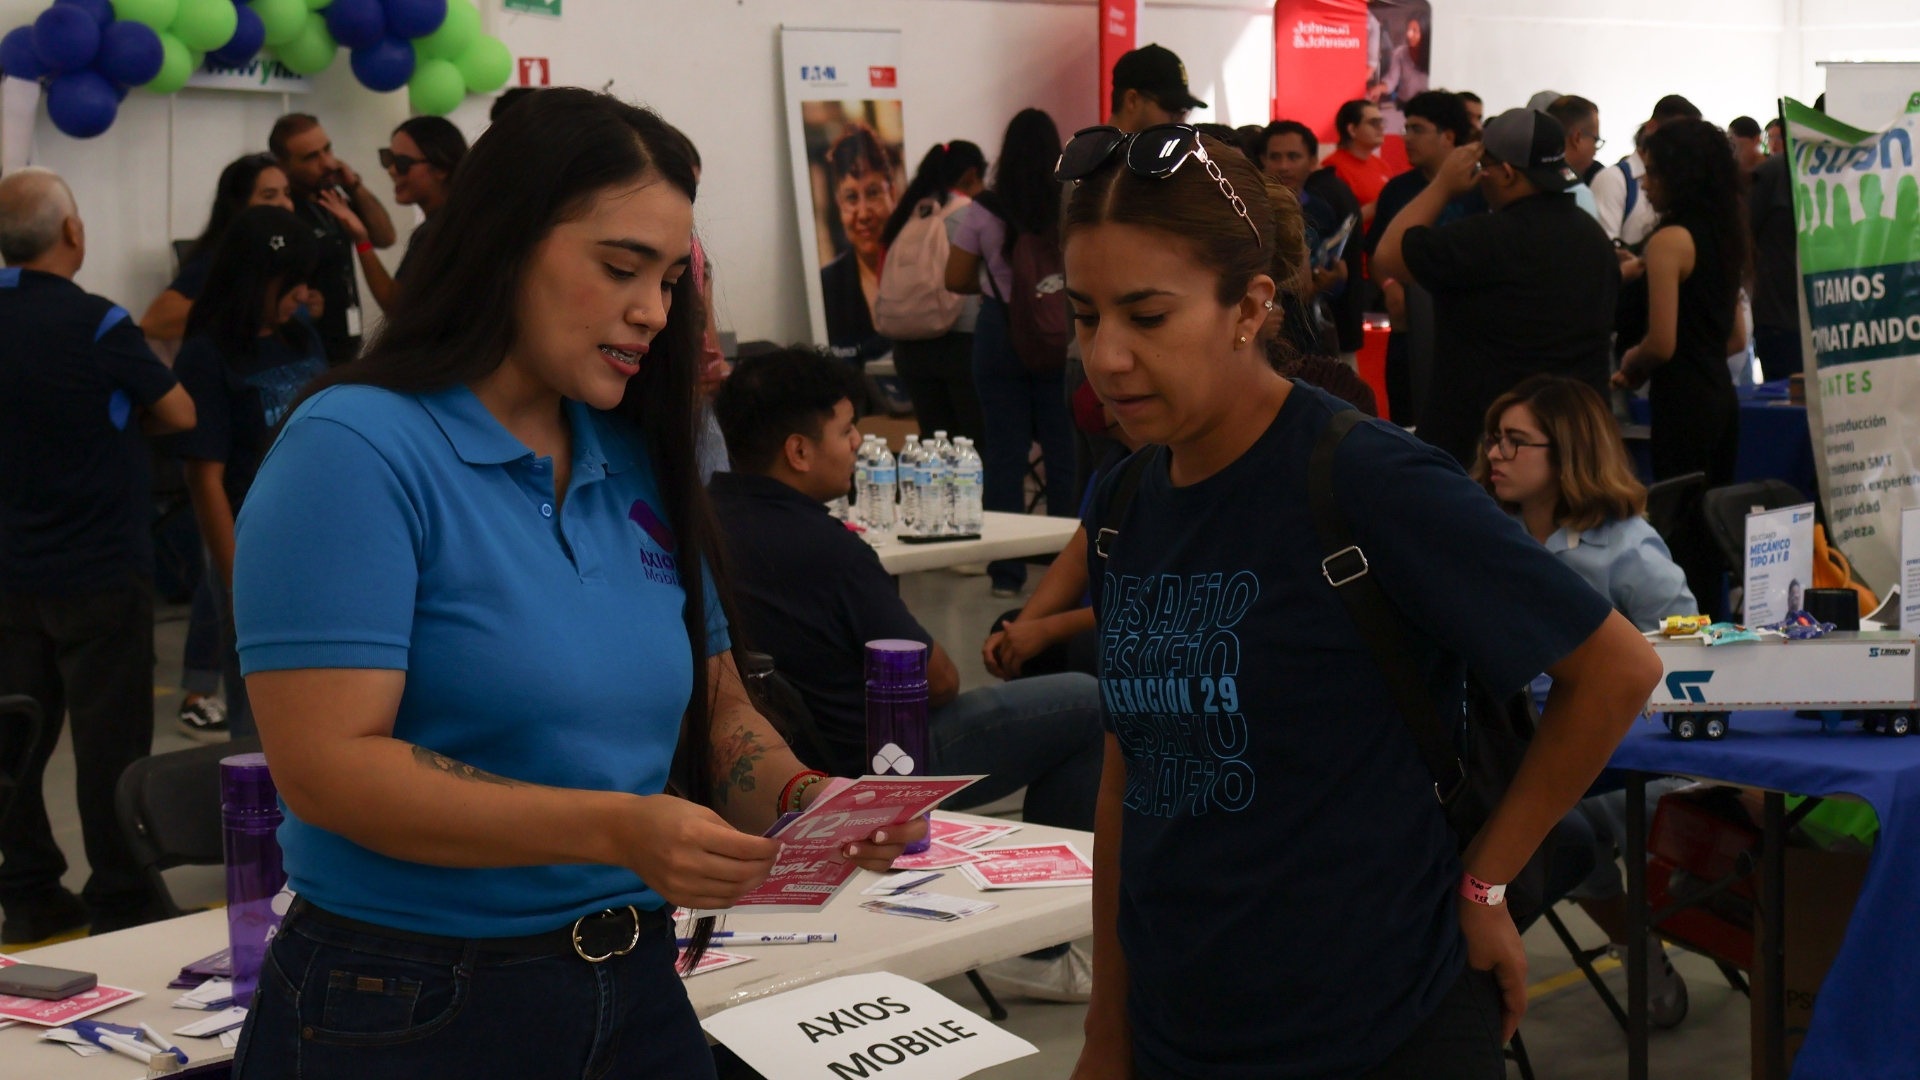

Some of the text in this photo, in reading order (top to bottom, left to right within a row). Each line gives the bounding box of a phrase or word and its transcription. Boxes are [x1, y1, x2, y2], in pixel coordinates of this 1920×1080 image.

[1750, 538, 1791, 556] MECÁNICO
[640, 548, 675, 571] AXIO
[1750, 555, 1768, 568] TIPO
[1769, 553, 1775, 565] A
[1783, 550, 1790, 562] B
[1101, 670, 1239, 713] NERACIÓN 29
[885, 789, 944, 798] AXIOS
[794, 812, 892, 840] 12 meses
[769, 860, 829, 876] RIPLE
[797, 996, 911, 1044] AXIOS
[826, 1019, 978, 1080] MOBILE
